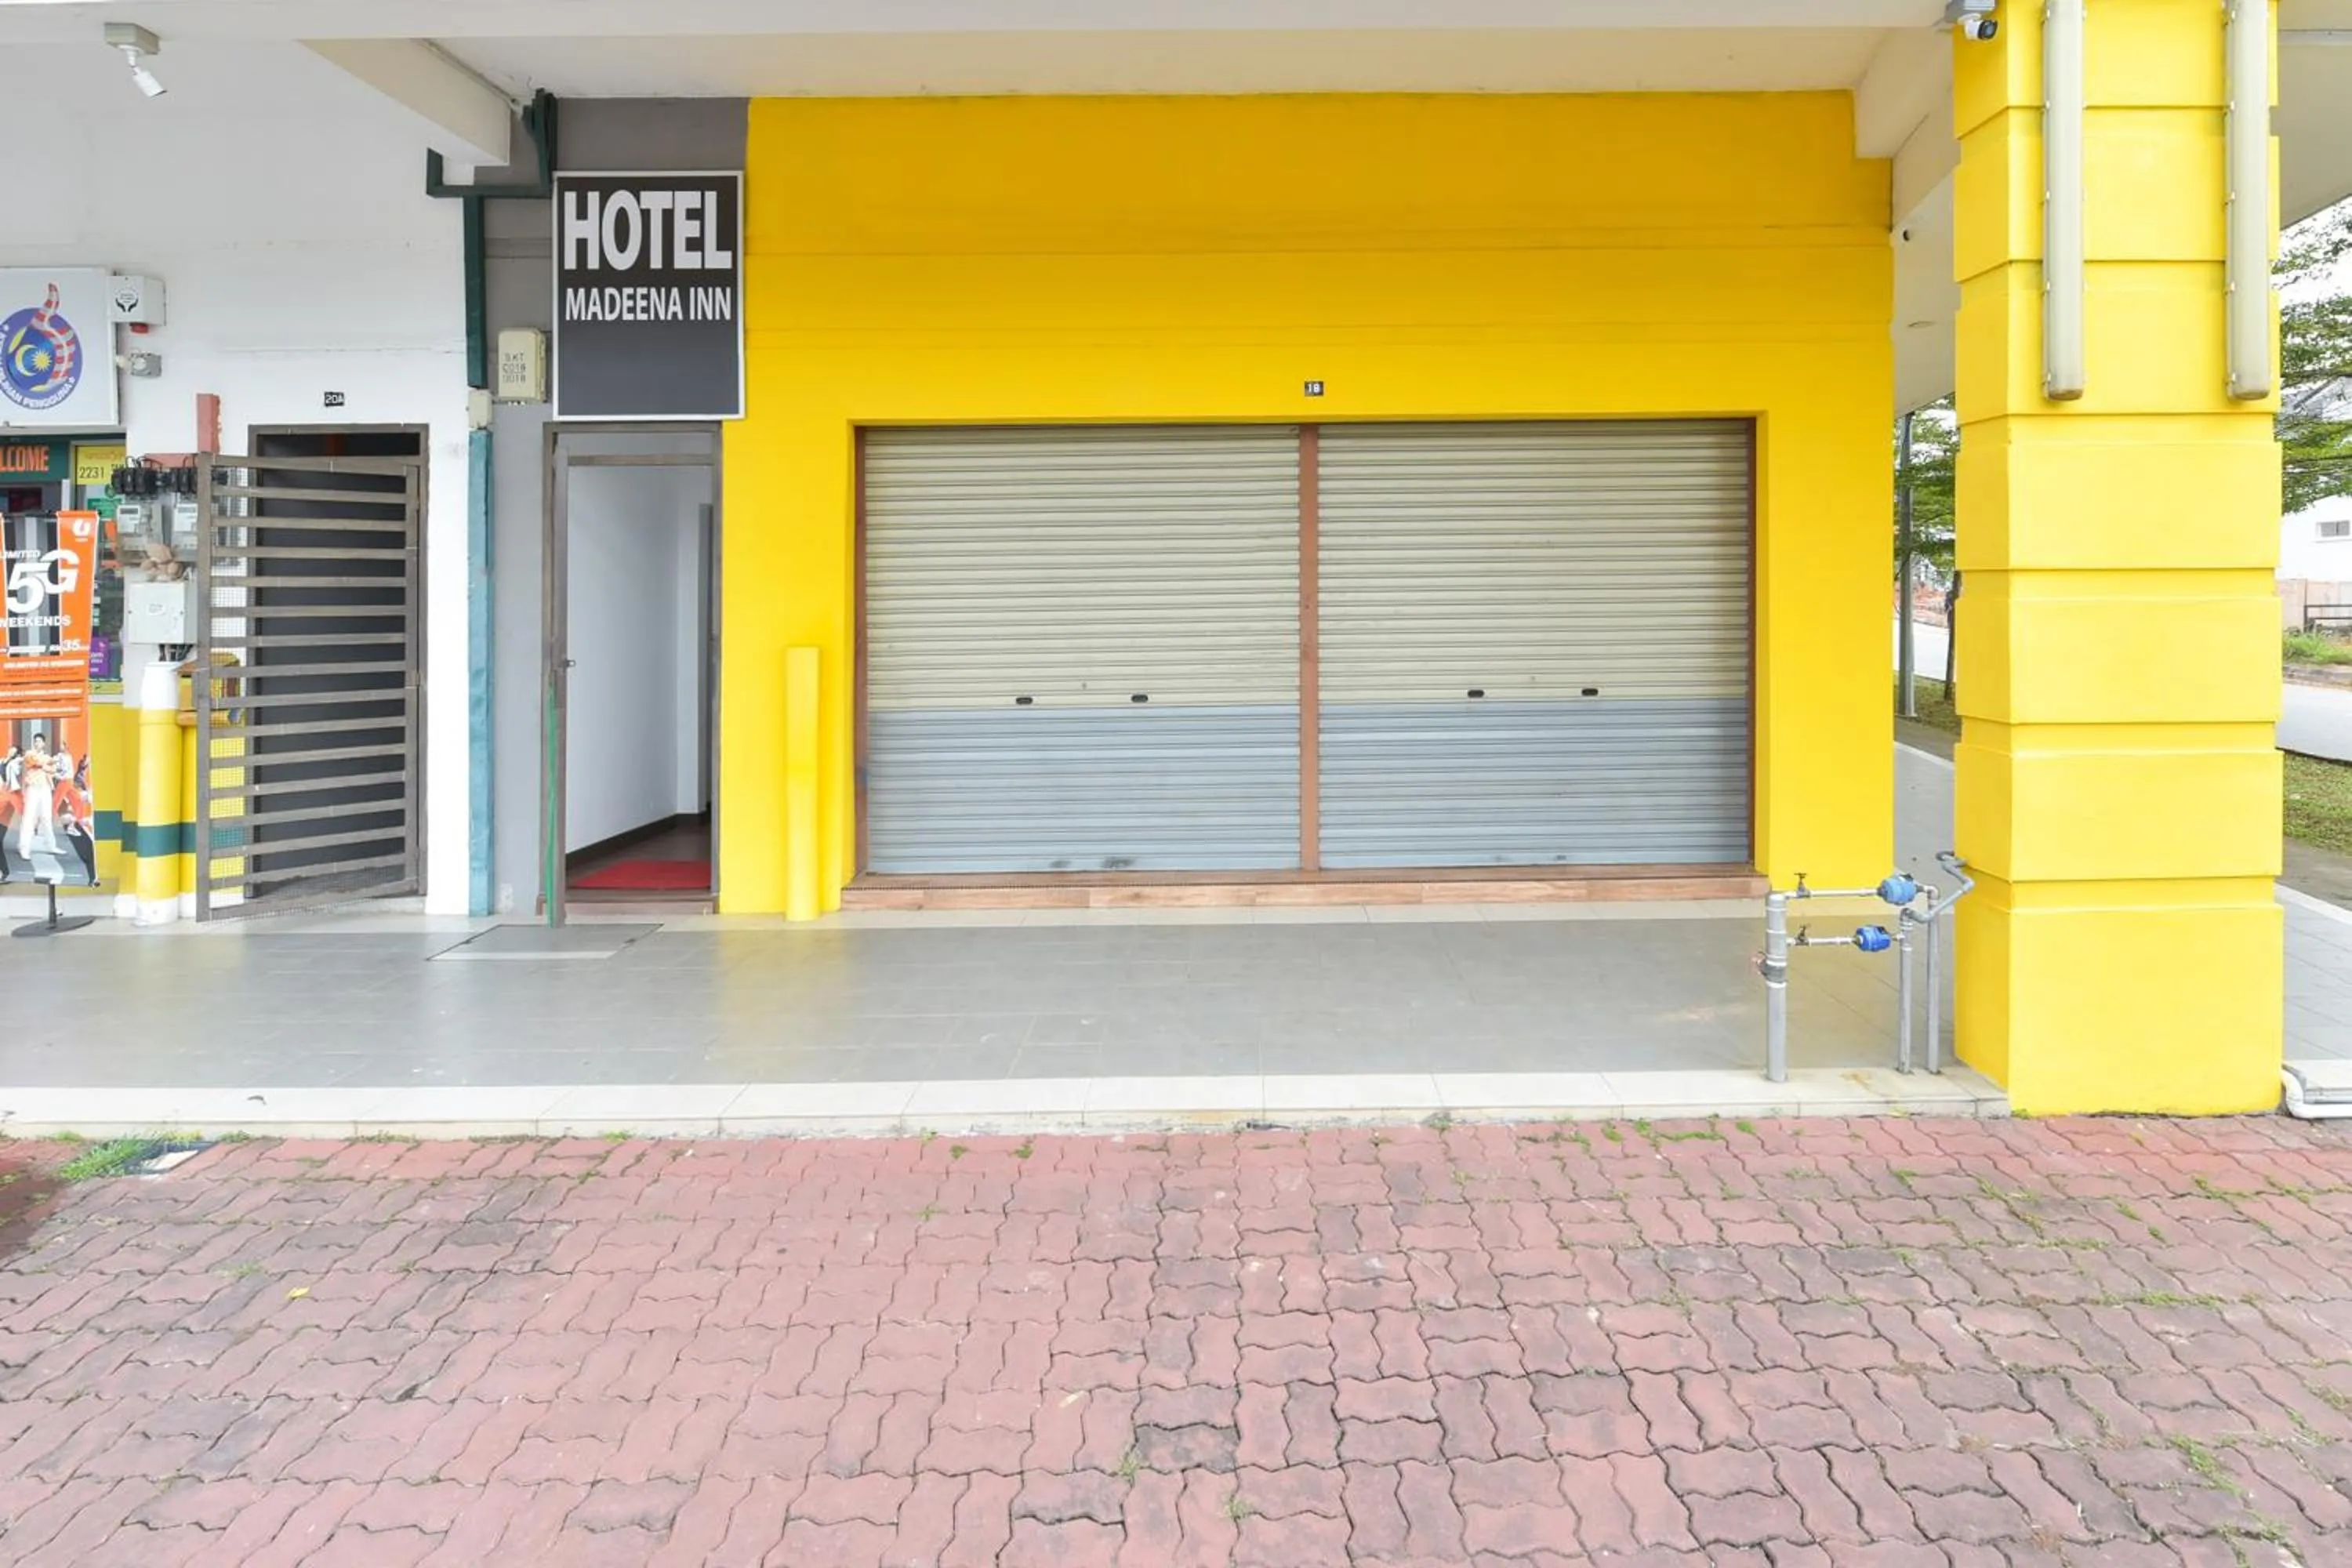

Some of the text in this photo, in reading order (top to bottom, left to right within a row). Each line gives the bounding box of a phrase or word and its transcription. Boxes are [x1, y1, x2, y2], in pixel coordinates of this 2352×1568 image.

[564, 190, 732, 270] HOTEL
[565, 287, 731, 321] MADEENA INN
[79, 466, 104, 480] 2231
[6, 550, 80, 614] 5G
